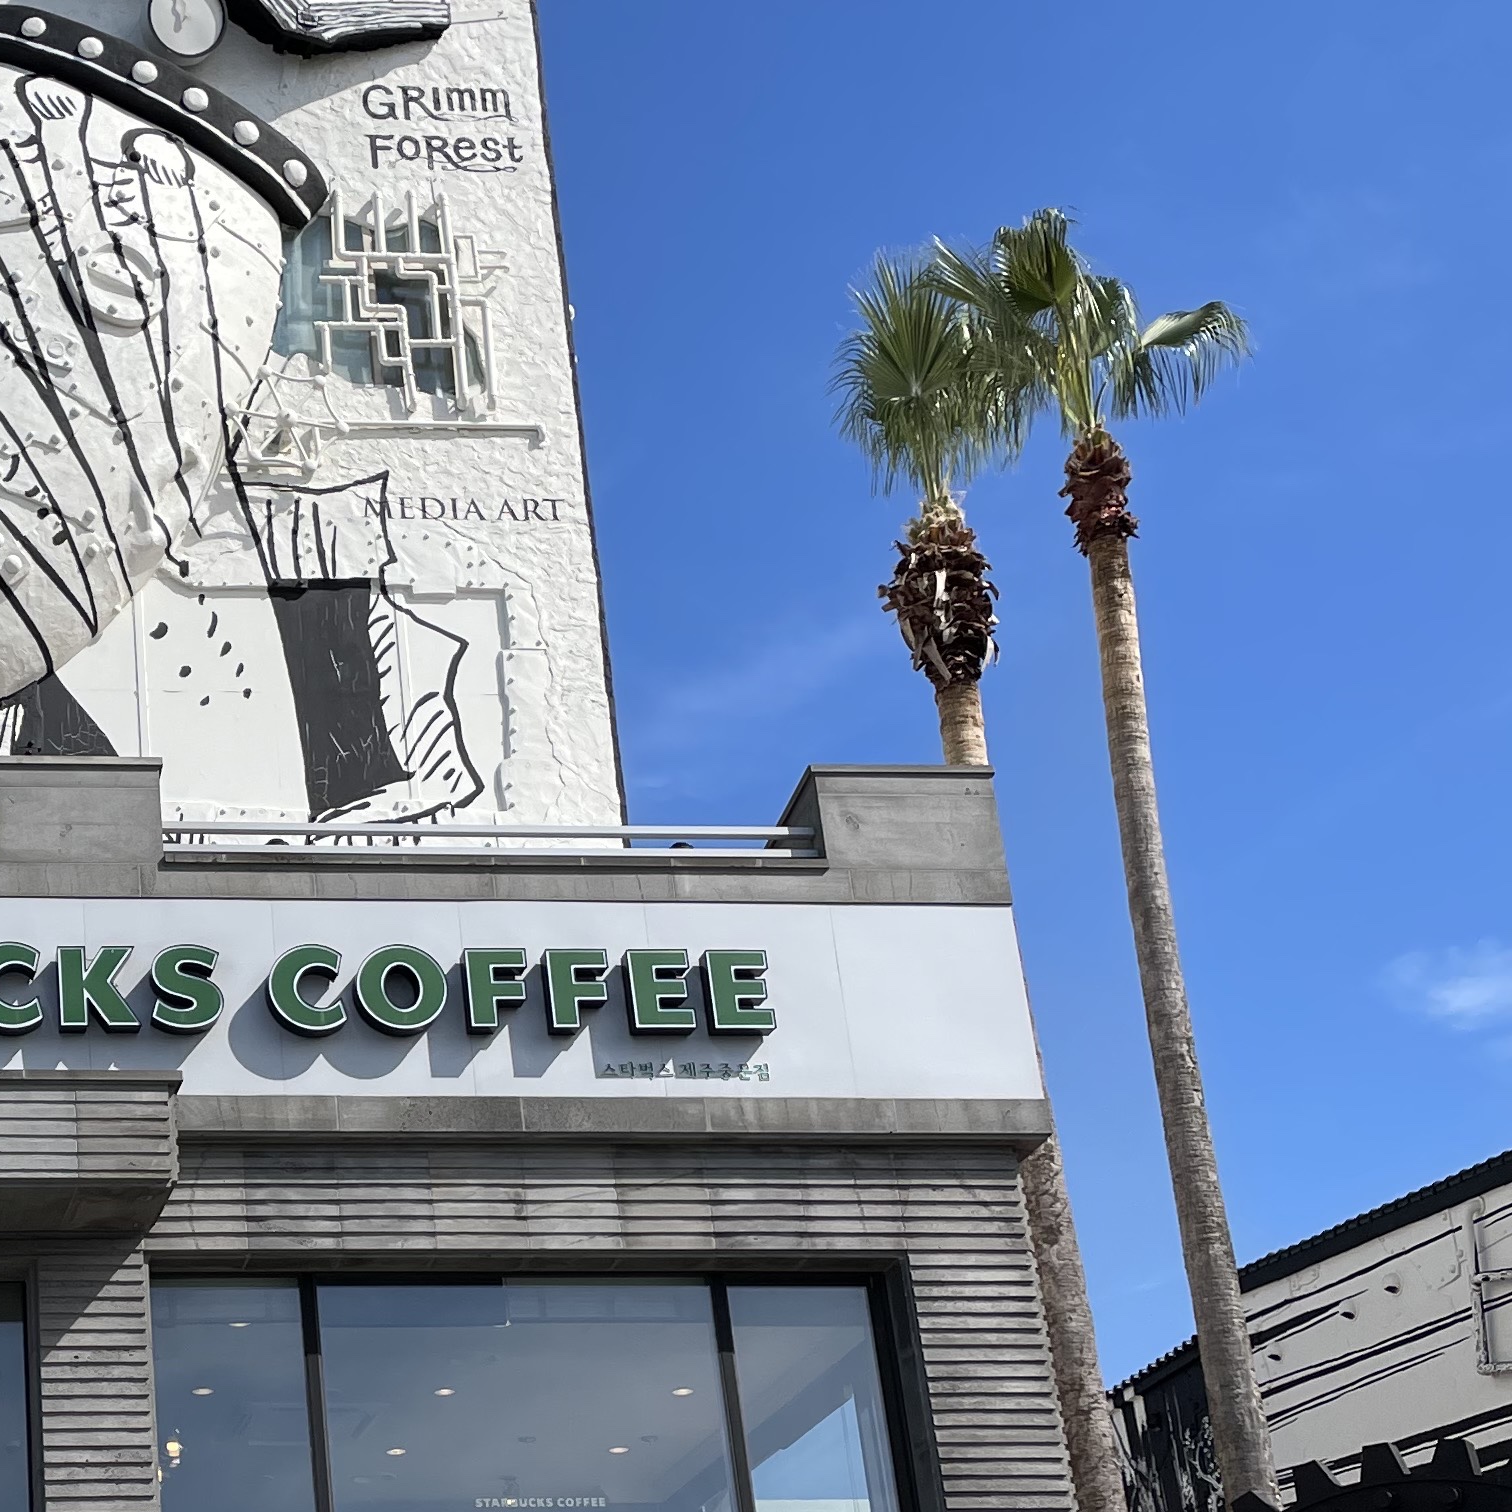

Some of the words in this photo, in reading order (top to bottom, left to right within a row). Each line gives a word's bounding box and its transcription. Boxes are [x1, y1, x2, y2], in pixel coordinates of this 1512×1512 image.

[364, 497, 486, 520] MEDIA
[497, 498, 565, 521] ART
[266, 943, 776, 1037] COFFEE
[600, 1061, 675, 1081] 스타벅스
[556, 1497, 606, 1508] COFFEE
